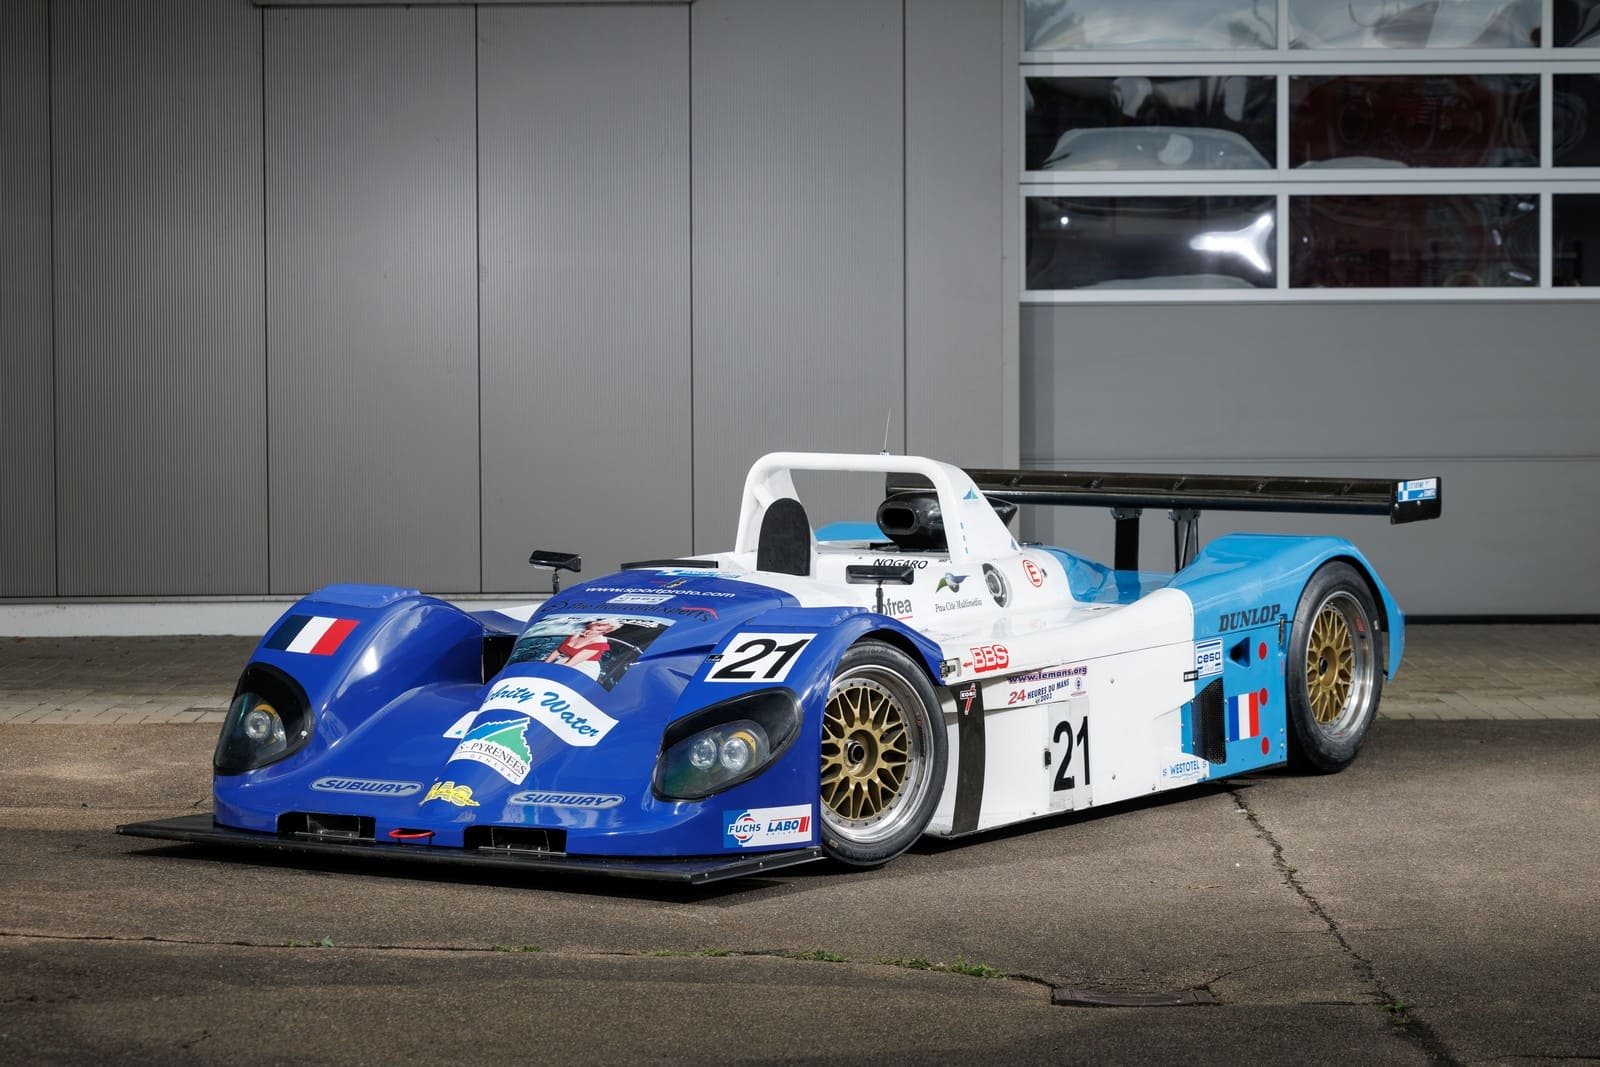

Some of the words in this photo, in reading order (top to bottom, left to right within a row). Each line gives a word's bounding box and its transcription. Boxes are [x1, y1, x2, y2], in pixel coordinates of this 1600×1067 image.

[873, 558, 929, 570] NOGARO
[585, 586, 736, 599] www.sportproto.com
[1218, 603, 1281, 633] DUNLOP
[712, 638, 811, 679] 21
[970, 644, 1009, 674] BBS
[1007, 665, 1087, 685] www.lemans.org
[1007, 689, 1026, 705] 24
[1027, 686, 1048, 700] HEURES
[1048, 684, 1056, 693] DU
[1056, 679, 1070, 690] MANS
[540, 691, 600, 738] Water
[1053, 715, 1091, 792] 21
[1169, 759, 1200, 775] WESTOTEL
[316, 778, 418, 794] SUBWAY
[514, 793, 619, 806] SUBWAY
[728, 823, 762, 834] FUCHS
[767, 819, 800, 833] LABO
